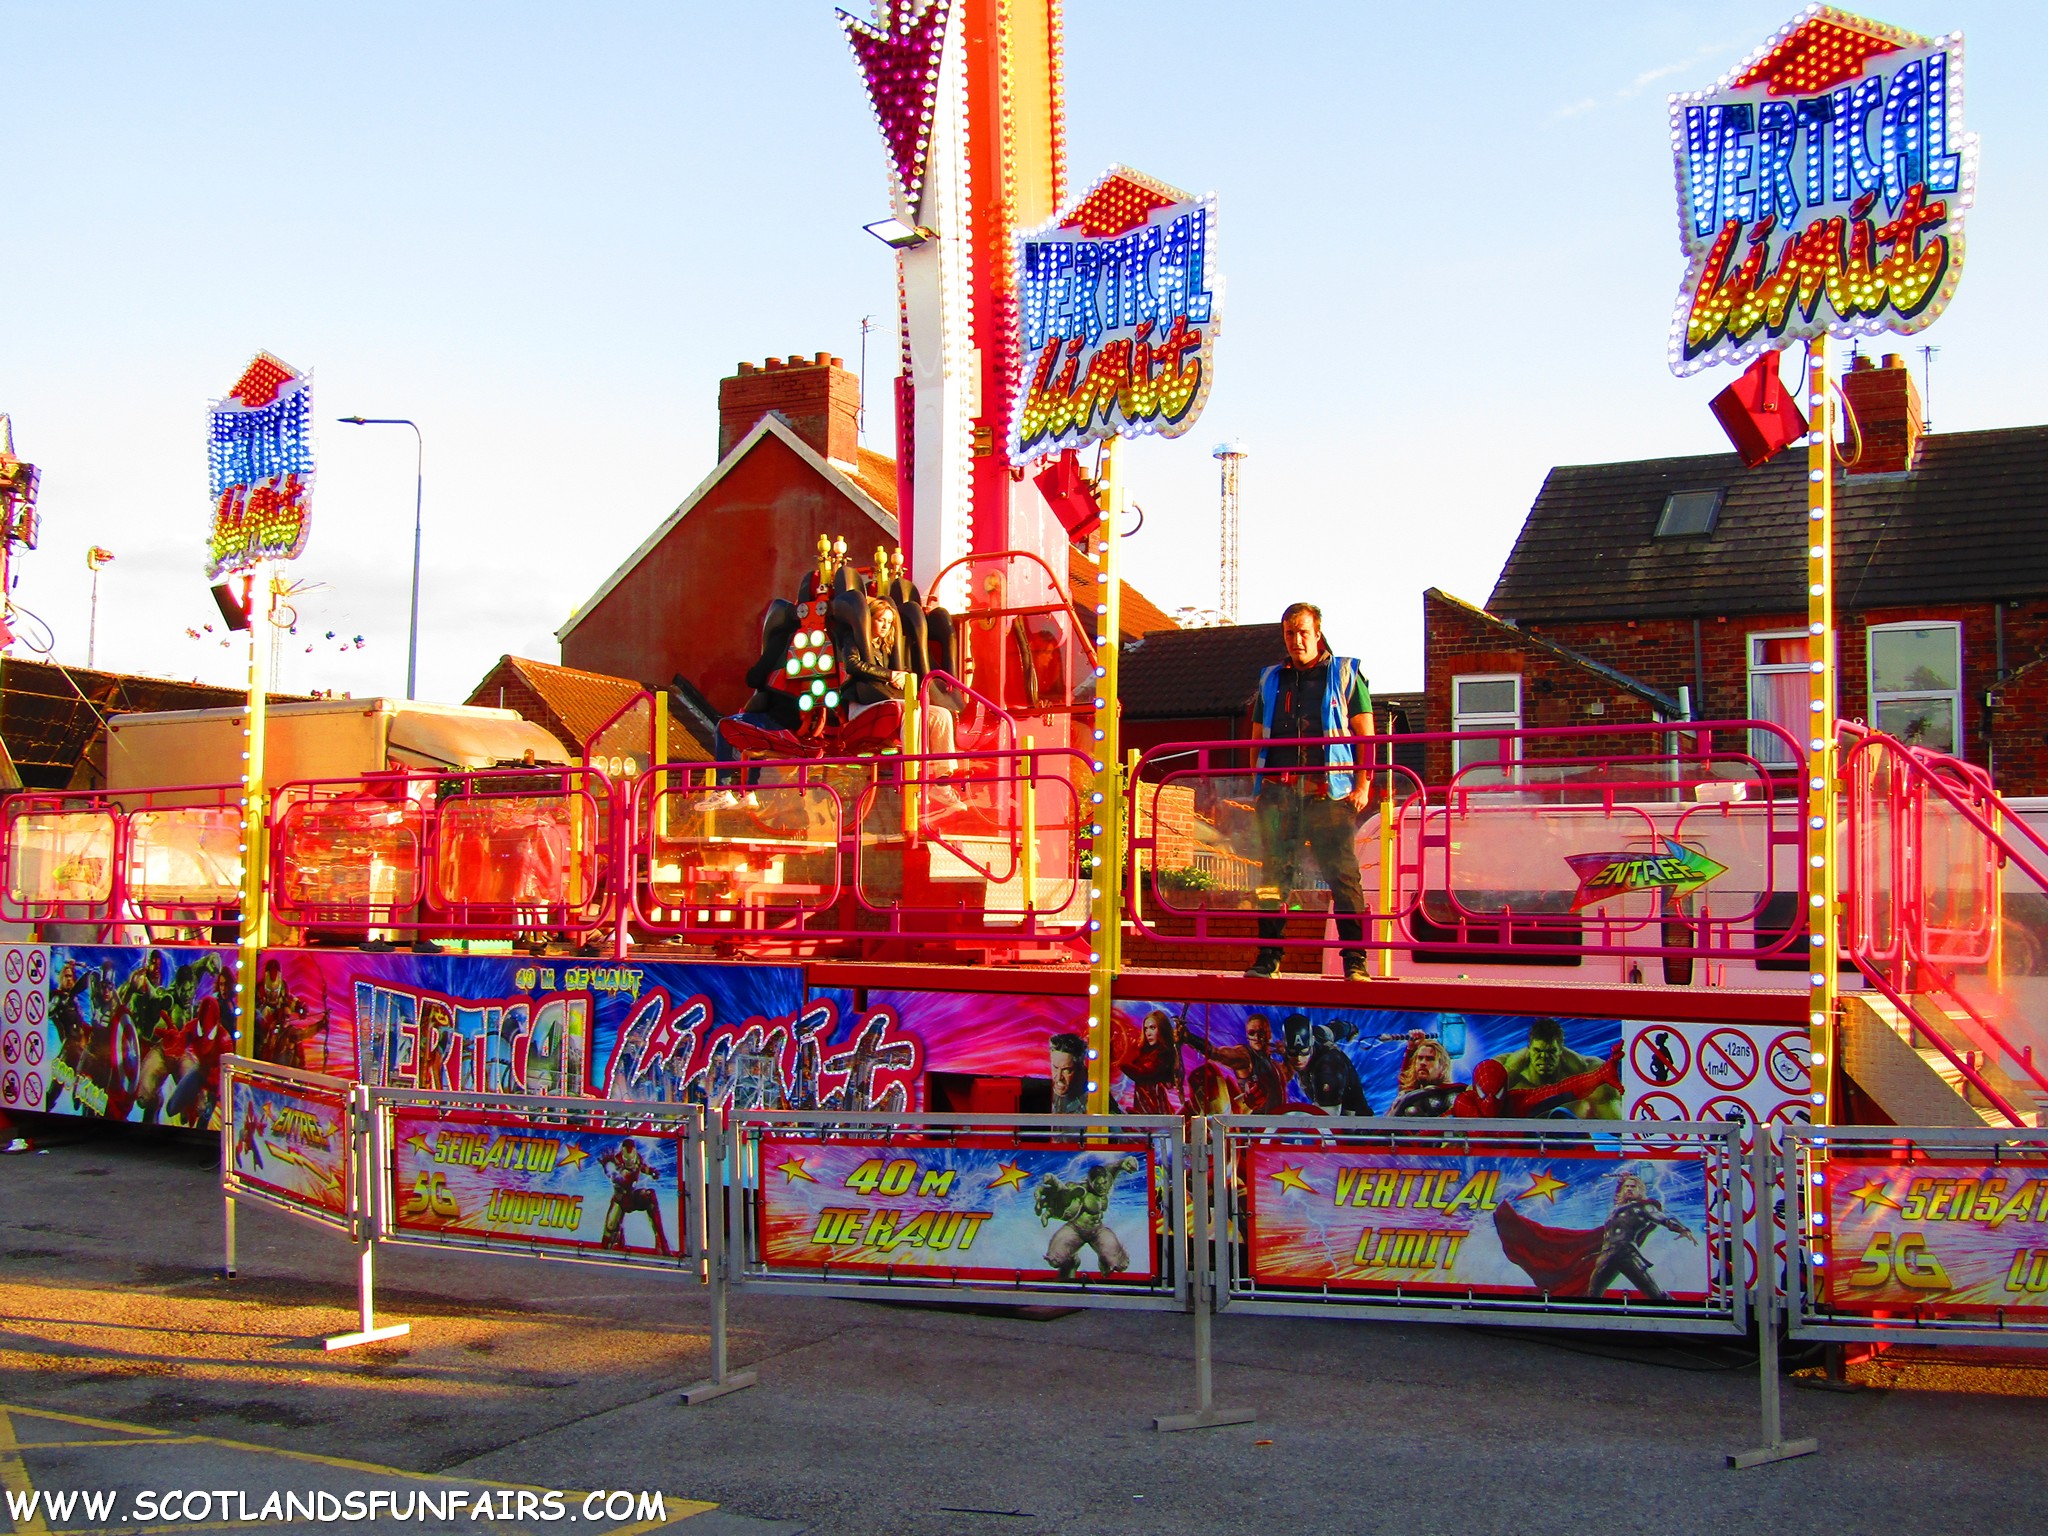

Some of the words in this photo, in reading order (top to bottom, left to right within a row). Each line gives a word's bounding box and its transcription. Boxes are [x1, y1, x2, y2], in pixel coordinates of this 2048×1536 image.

[1685, 52, 1961, 238] VERTICAL
[1024, 208, 1213, 350] VERTICAL
[515, 967, 537, 990] 40
[540, 967, 557, 990] M
[565, 968, 589, 991] DE
[593, 967, 643, 995] HAUT
[354, 980, 597, 1126] VERTICAL
[1704, 1061, 1729, 1077] -1m40
[1724, 1042, 1751, 1058] -12ans
[433, 1130, 560, 1173] SENSATION
[406, 1170, 460, 1217] 5G
[486, 1188, 584, 1231] LOOPING
[844, 1158, 917, 1197] 40
[918, 1168, 957, 1198] M
[1333, 1166, 1500, 1216] VERTICAL
[811, 1207, 868, 1246] DE
[862, 1207, 994, 1253] HAUT
[1353, 1226, 1470, 1270] LIMIT
[1848, 1230, 1953, 1290] 5G
